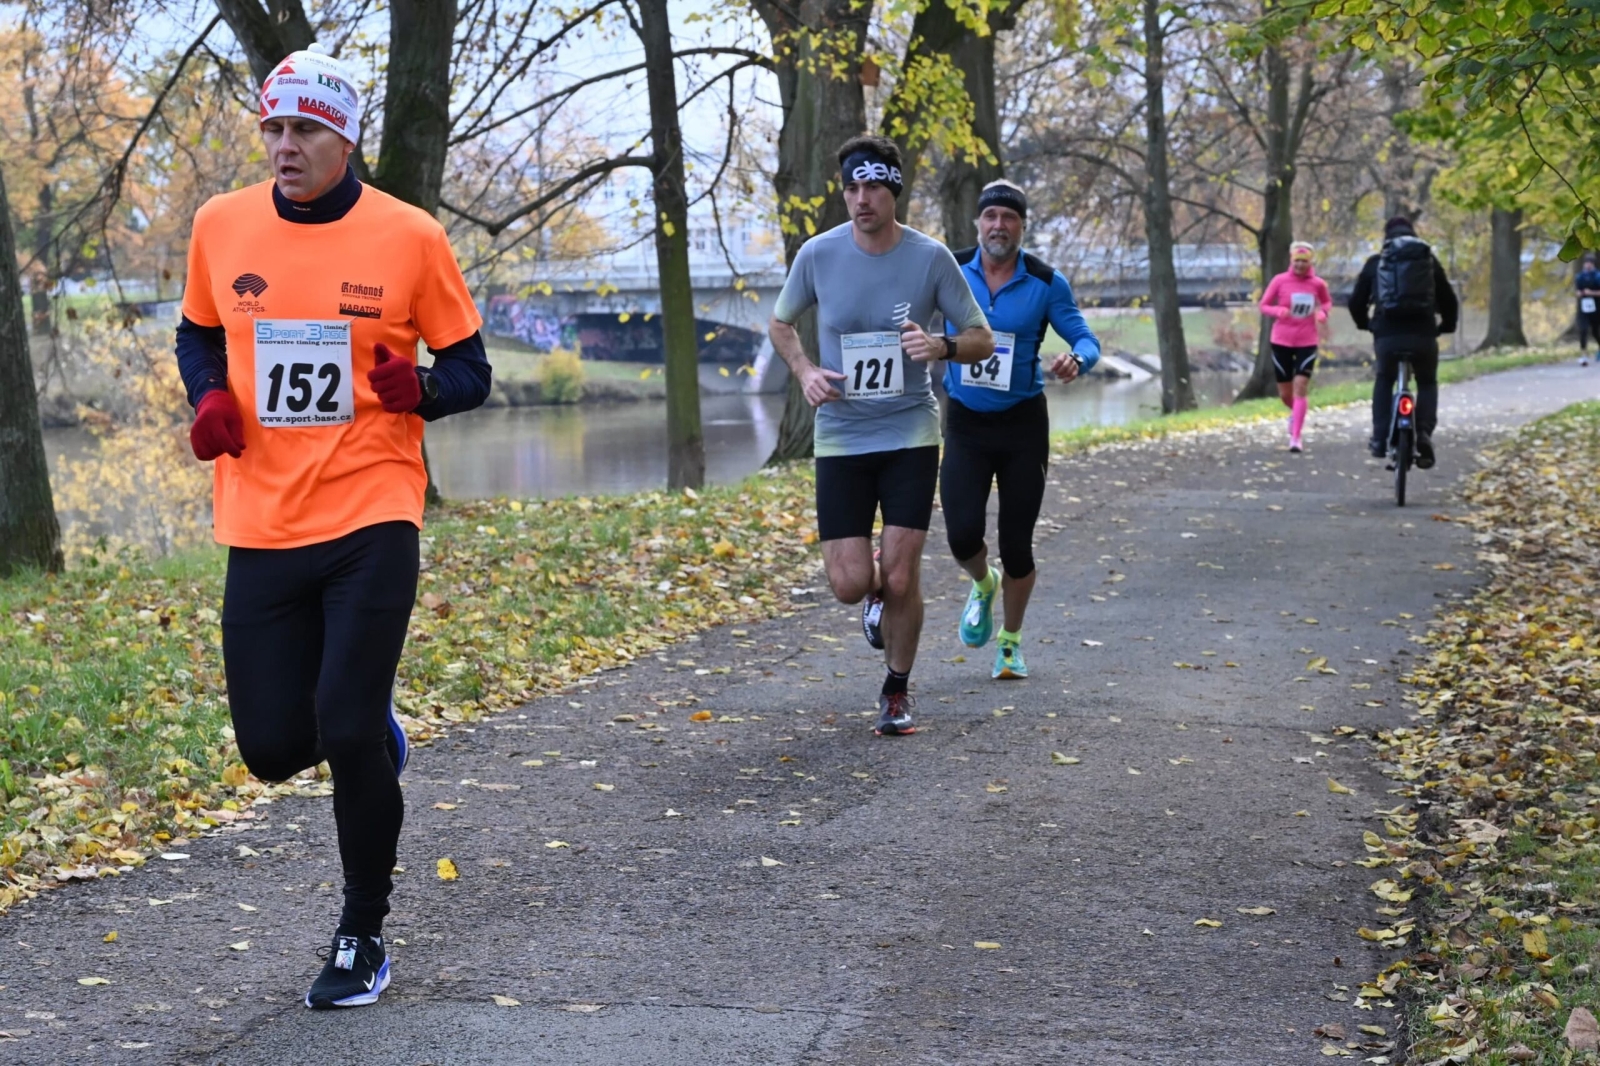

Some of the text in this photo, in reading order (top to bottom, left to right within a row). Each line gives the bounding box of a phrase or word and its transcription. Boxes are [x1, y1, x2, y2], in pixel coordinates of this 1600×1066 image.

[317, 73, 342, 93] LES
[297, 96, 348, 125] MARATON
[852, 160, 903, 185] eleve
[339, 302, 383, 314] MARATON
[853, 357, 894, 391] 121
[970, 354, 1001, 381] 64
[267, 362, 341, 412] 152
[259, 415, 352, 424] www.sport-base.cz
